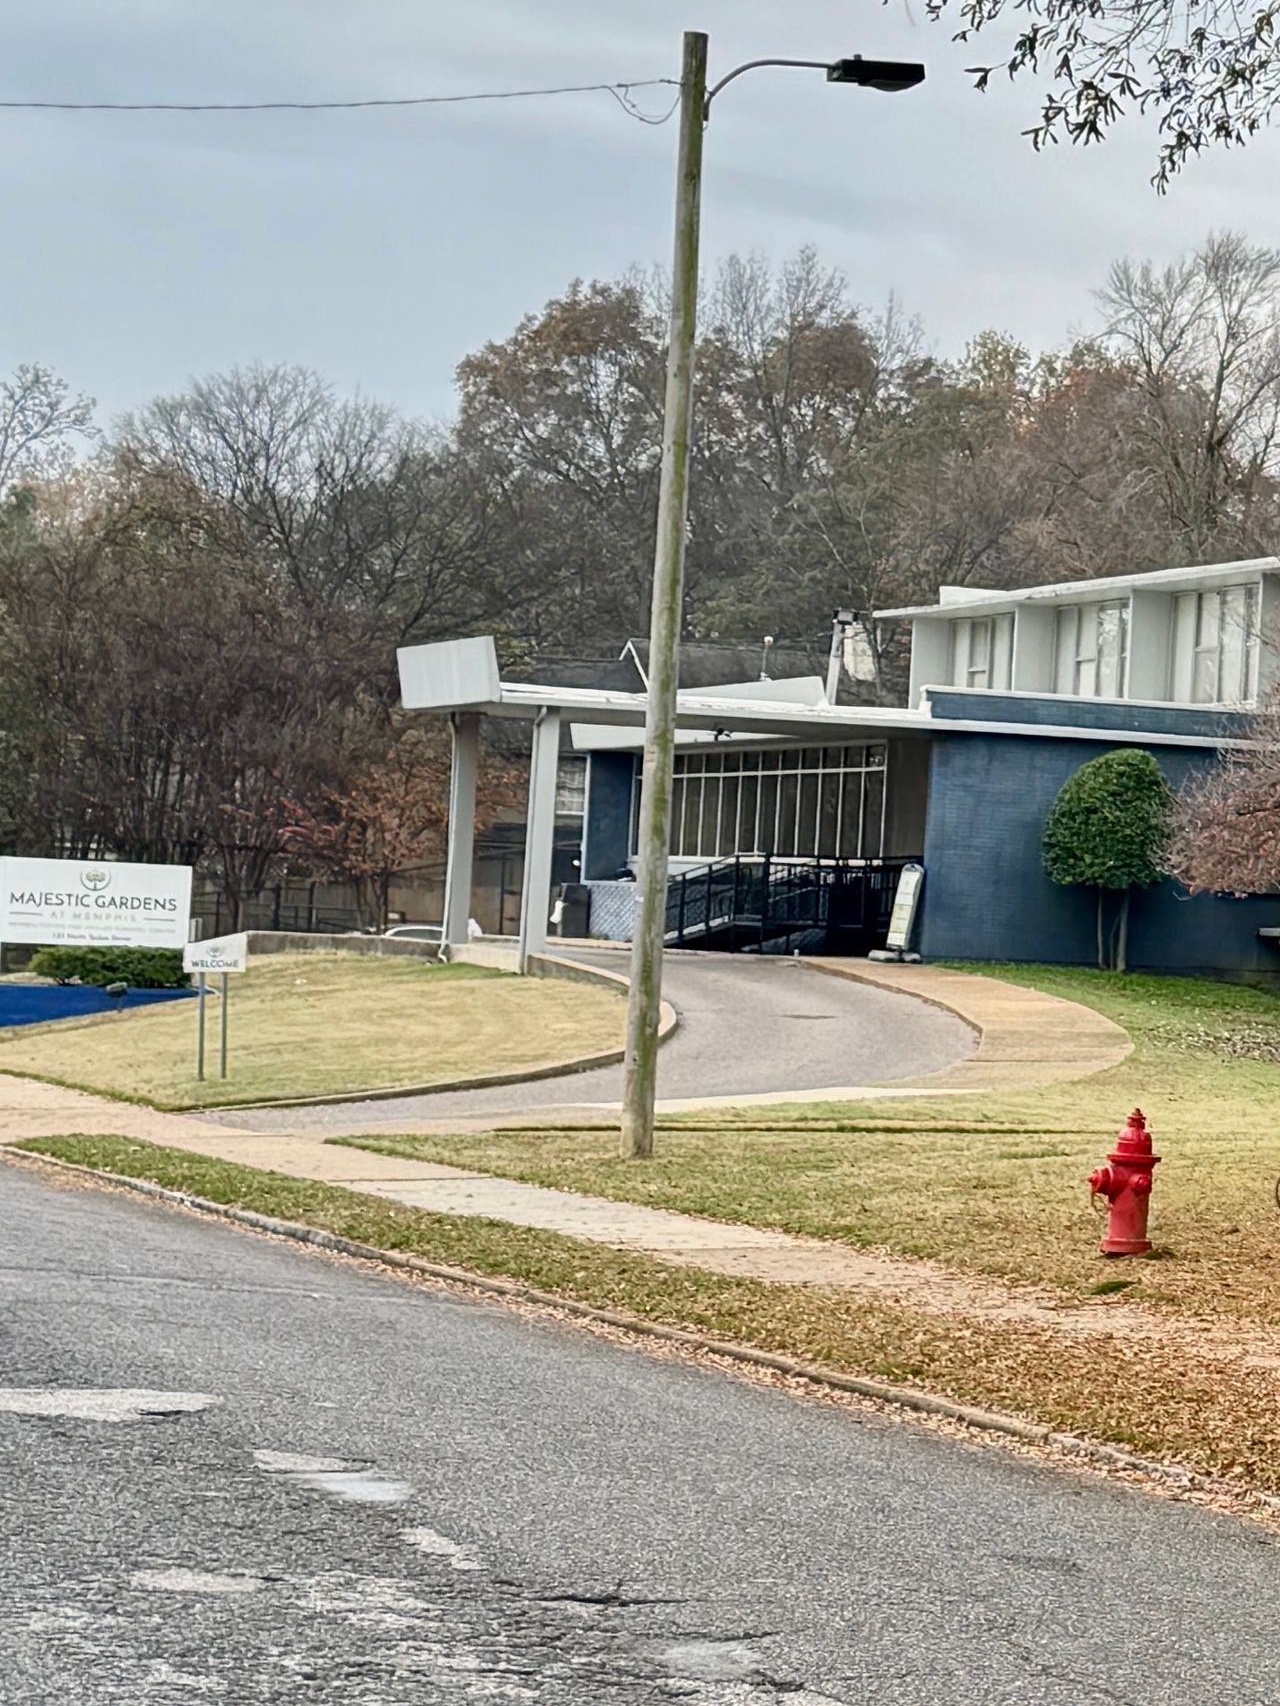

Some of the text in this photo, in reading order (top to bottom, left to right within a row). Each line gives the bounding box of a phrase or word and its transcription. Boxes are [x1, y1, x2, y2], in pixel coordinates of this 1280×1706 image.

[10, 892, 177, 911] MAJESTIC GARDENS
[191, 959, 239, 968] WELCOME
